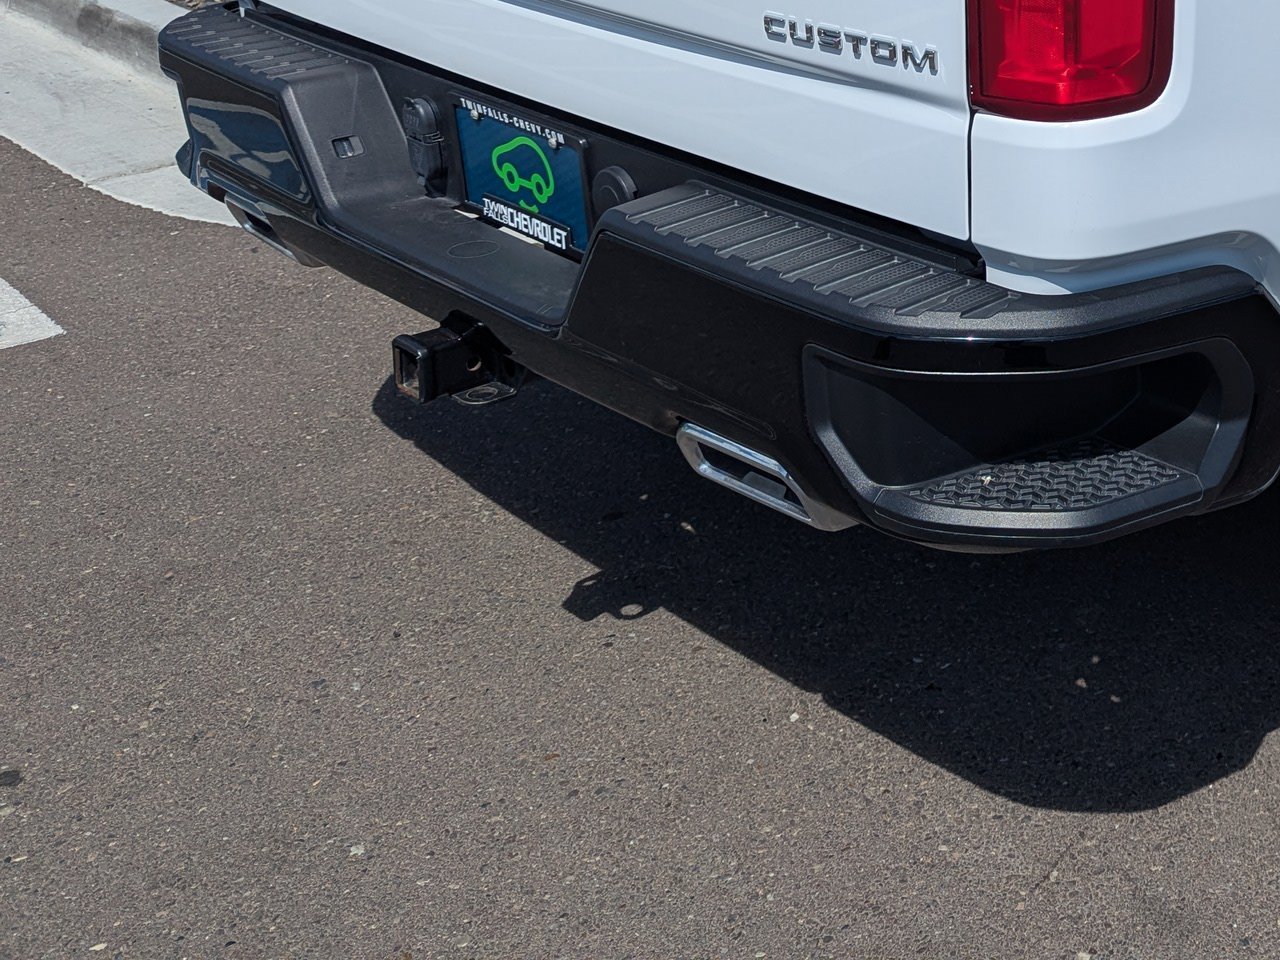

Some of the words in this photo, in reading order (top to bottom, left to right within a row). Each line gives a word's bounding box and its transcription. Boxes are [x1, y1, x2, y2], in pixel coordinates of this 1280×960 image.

[763, 13, 939, 76] CUSTOM
[460, 97, 566, 144] TWINFALLS-CHEVY.COM
[482, 197, 509, 214] TWIN
[483, 206, 509, 225] FALLS
[508, 208, 568, 250] CHEVROLET
